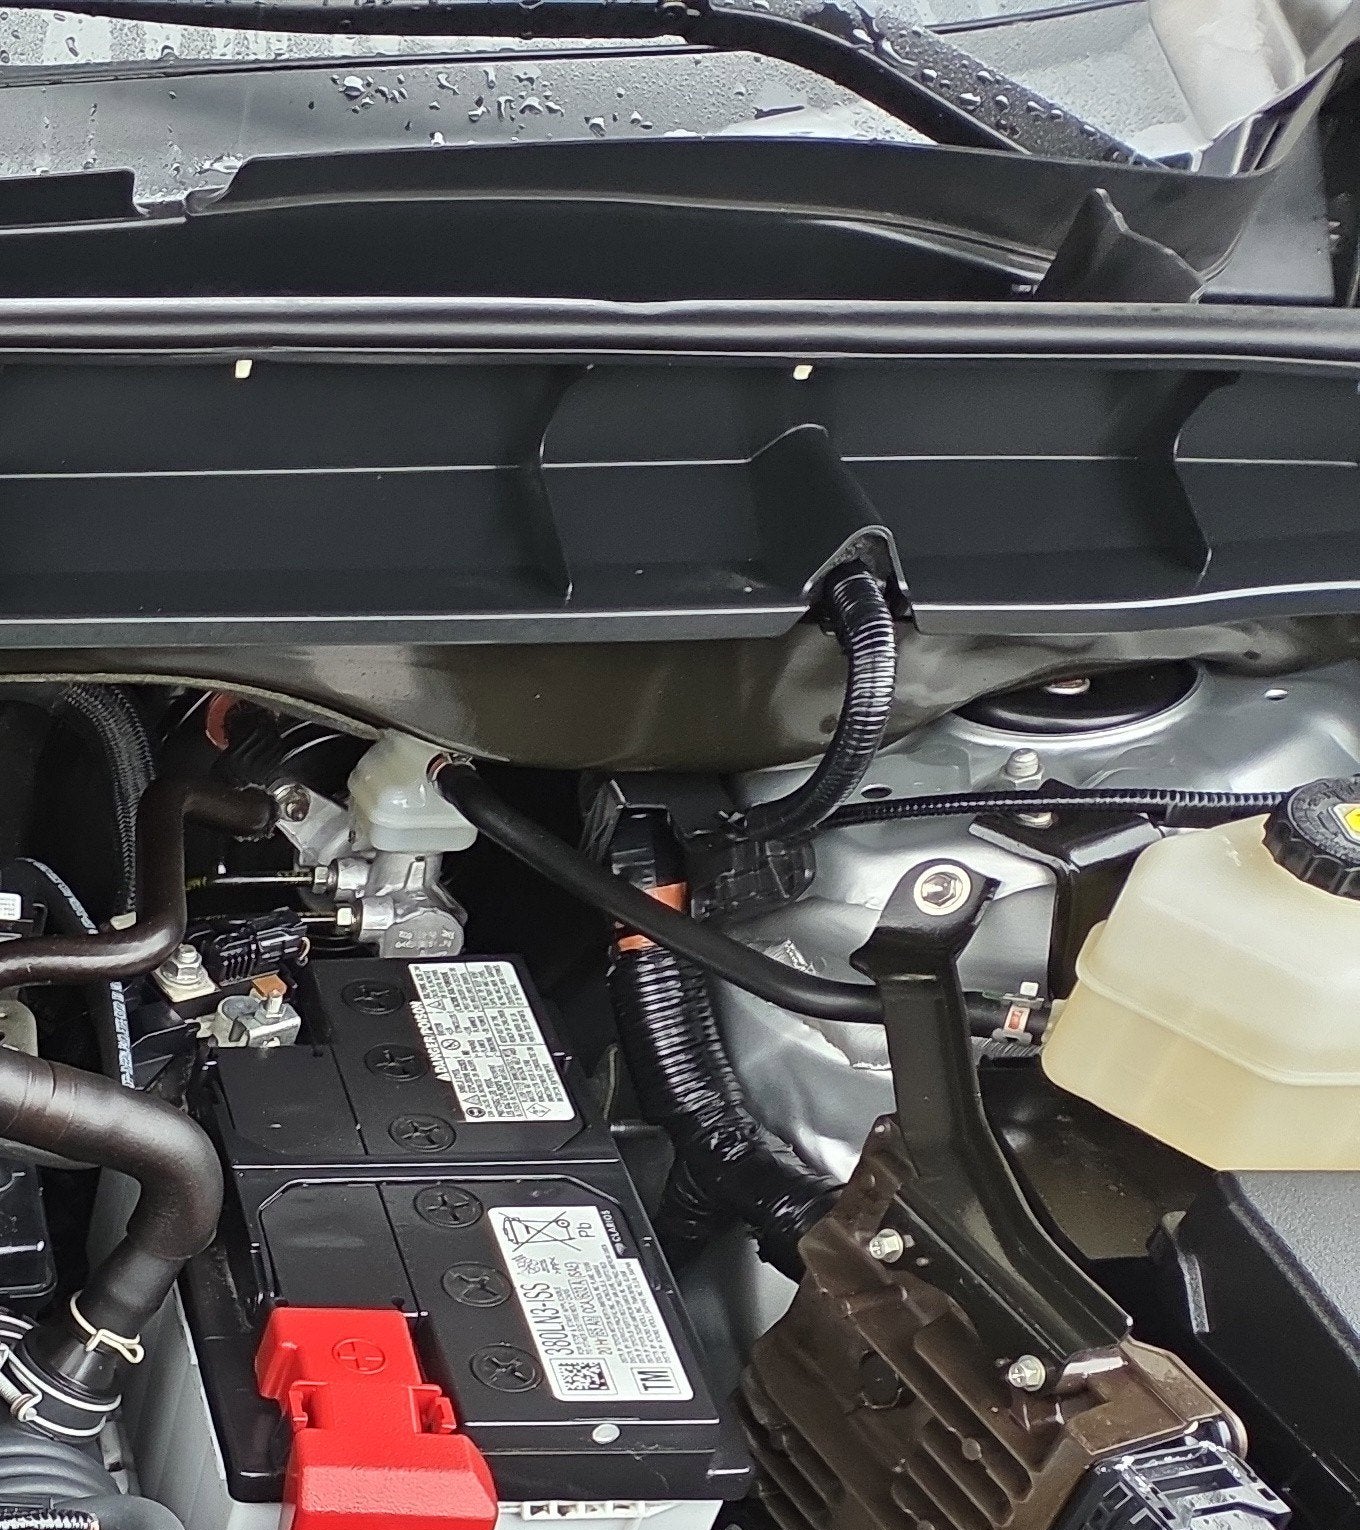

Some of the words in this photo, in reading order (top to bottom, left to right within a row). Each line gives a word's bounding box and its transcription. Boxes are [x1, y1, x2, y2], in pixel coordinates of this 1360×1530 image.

[576, 1222, 596, 1238] Pb
[601, 1209, 621, 1242] CLARIOS
[520, 1282, 575, 1356] 380LN3-ISS
[638, 1370, 674, 1392] TM
